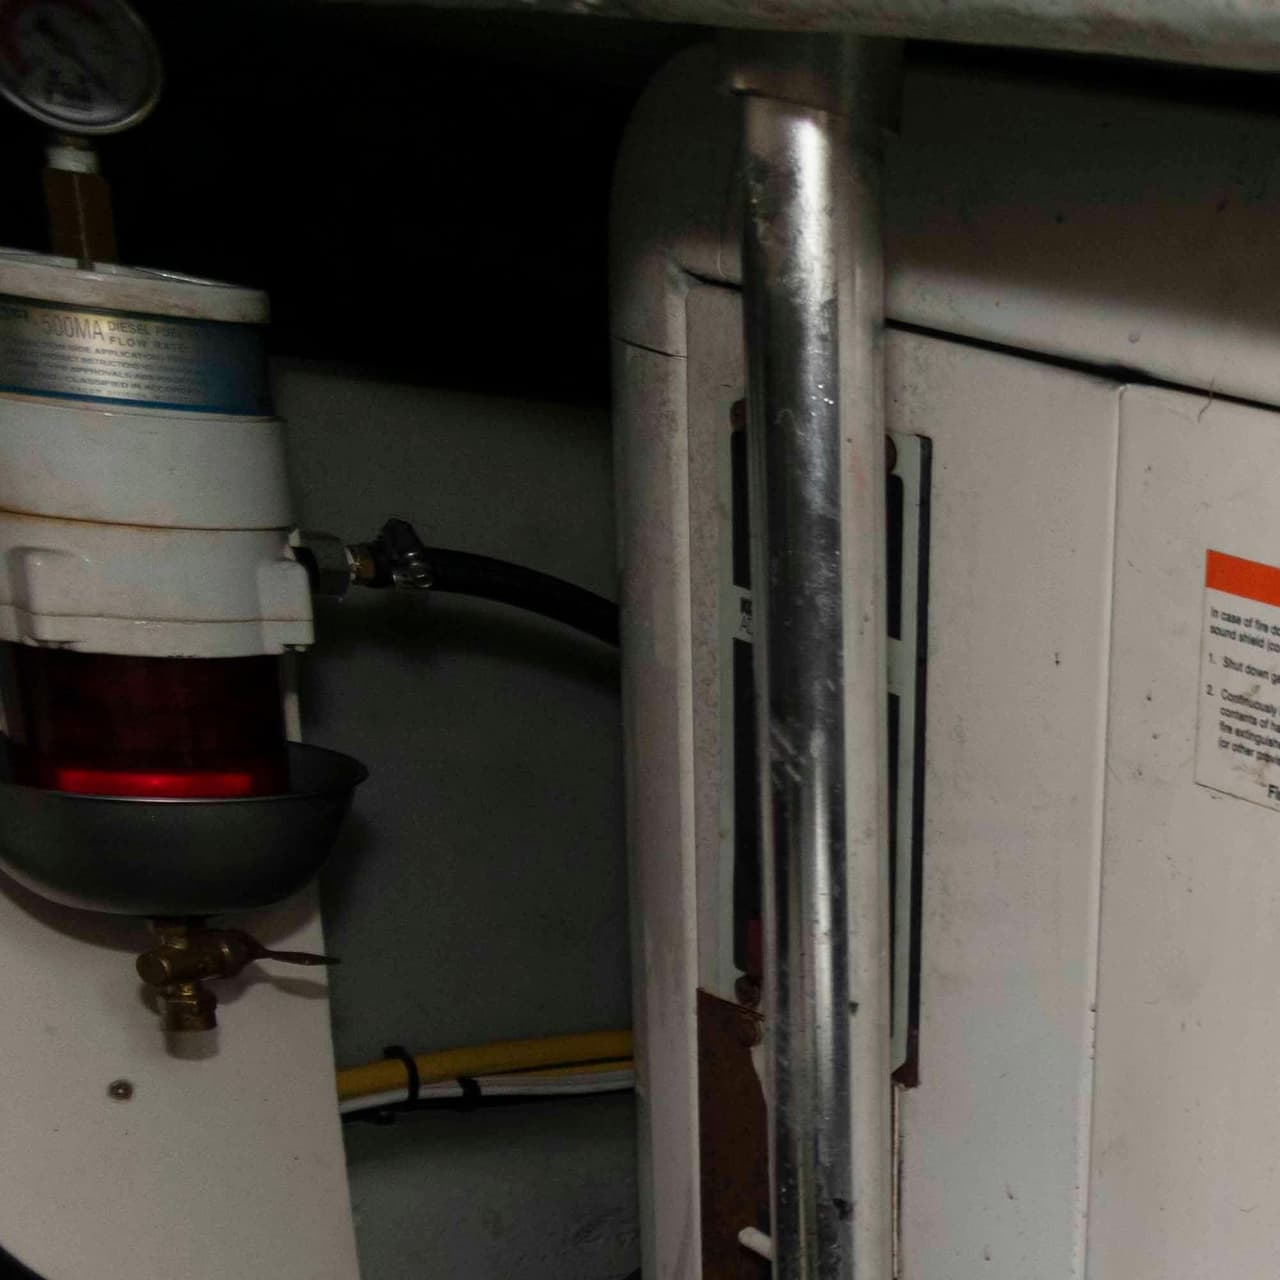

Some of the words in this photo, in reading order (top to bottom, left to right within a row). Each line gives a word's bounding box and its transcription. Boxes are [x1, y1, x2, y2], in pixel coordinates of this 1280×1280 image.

[108, 320, 150, 336] DIESEL
[1221, 611, 1242, 625] case
[1244, 617, 1253, 628] of
[1255, 619, 1269, 633] fire
[1210, 625, 1237, 640] sound
[1238, 632, 1265, 649] shield
[1223, 656, 1243, 672] Shut
[1245, 664, 1269, 680] down
[1221, 688, 1277, 716] Continuously
[1219, 720, 1233, 734] fire
[1220, 707, 1257, 726] contents
[1259, 718, 1269, 729] of
[1232, 742, 1253, 757] other
